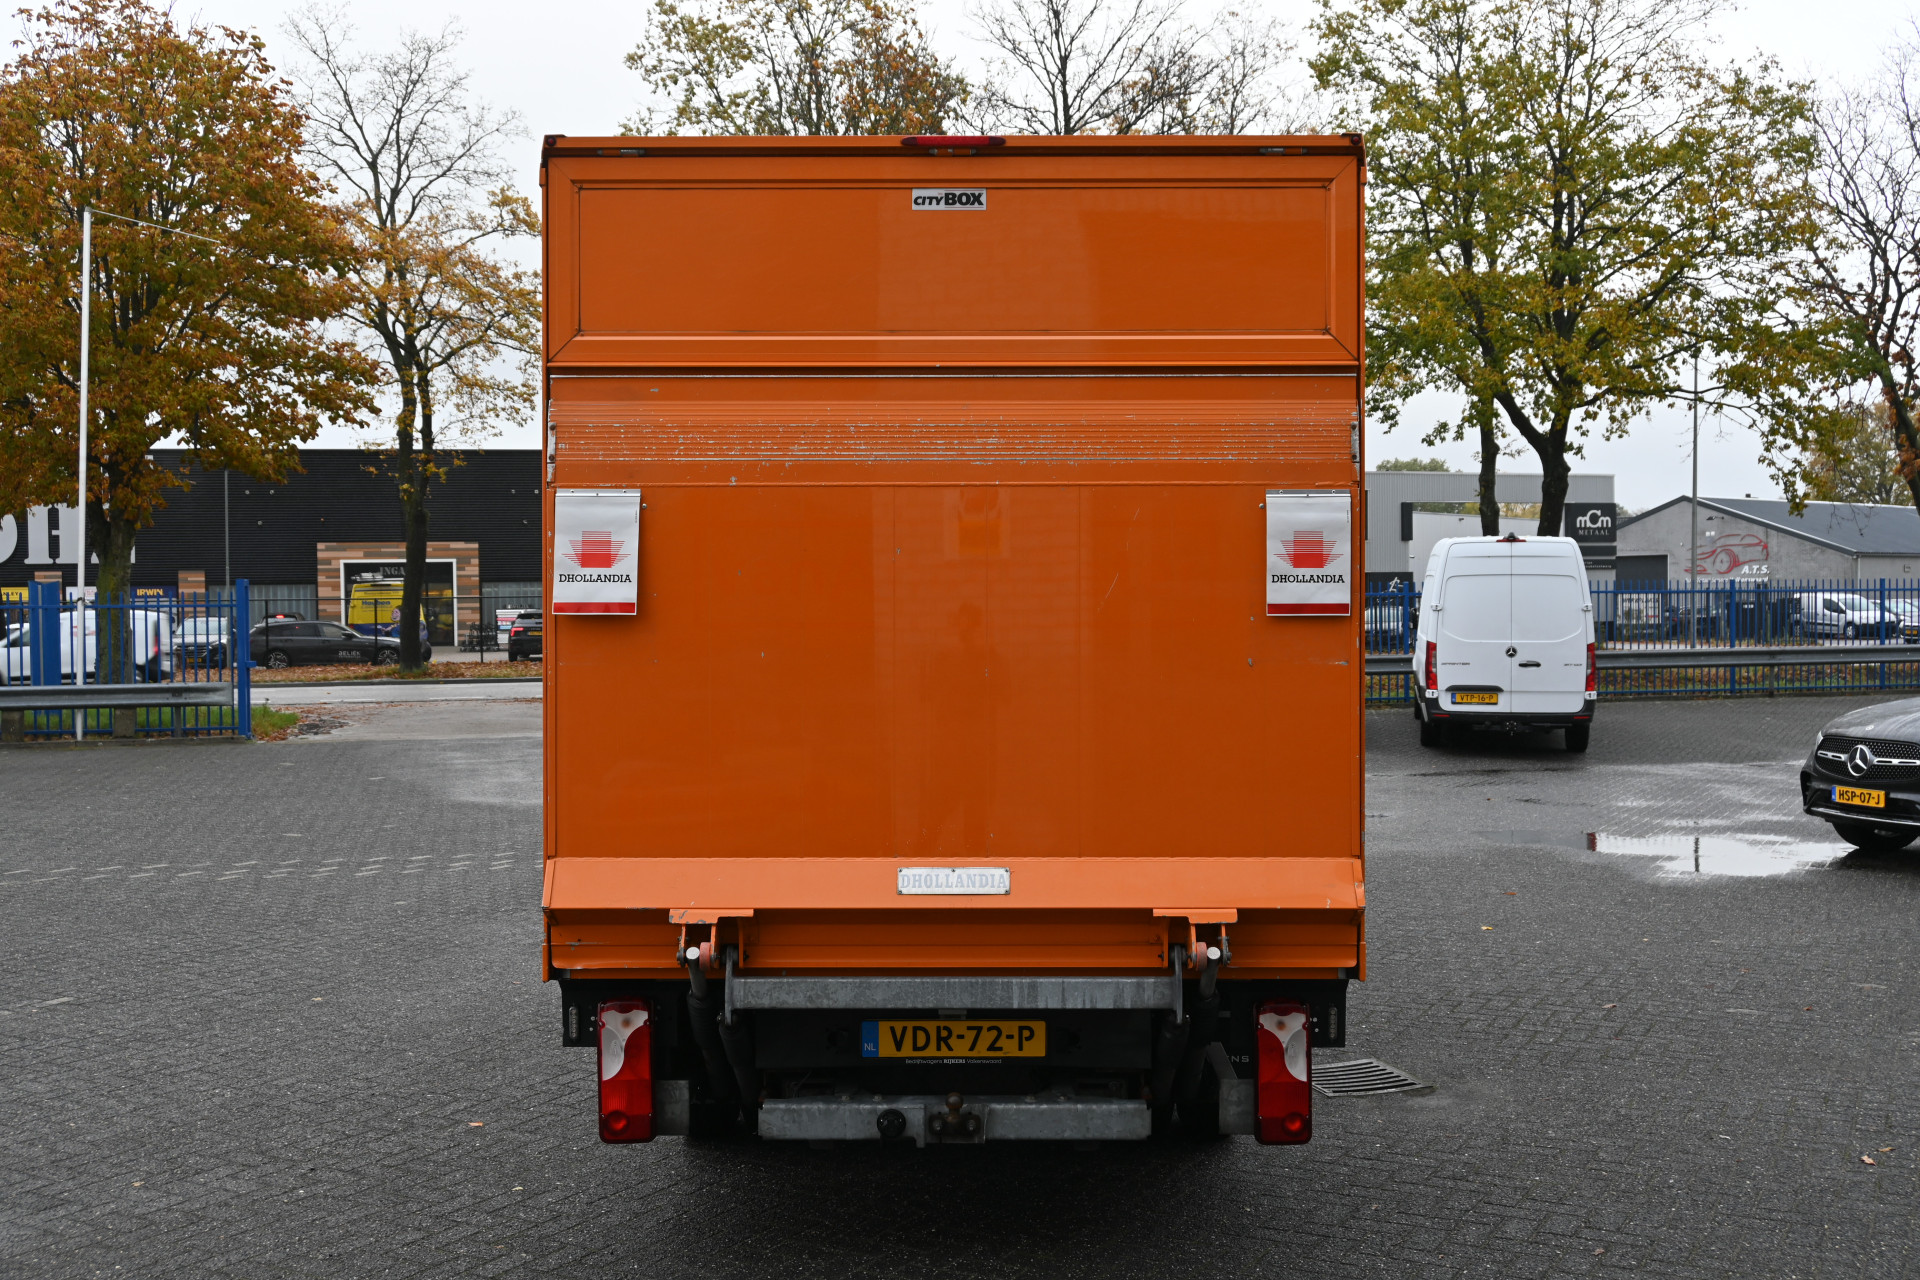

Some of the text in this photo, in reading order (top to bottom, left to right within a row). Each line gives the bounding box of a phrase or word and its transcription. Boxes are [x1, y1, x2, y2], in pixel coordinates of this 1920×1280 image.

[1741, 565, 1770, 574] A.T.S.
[558, 573, 632, 583] DHOLLANDIA
[1271, 574, 1345, 584] DHOLLANDIA
[136, 588, 164, 596] IRWIN
[1838, 789, 1880, 805] HSP-07-J
[900, 873, 1007, 889] DHOLLANDIA
[864, 1025, 1035, 1052] NL VDR-72-P
[1227, 1055, 1250, 1063] NS
